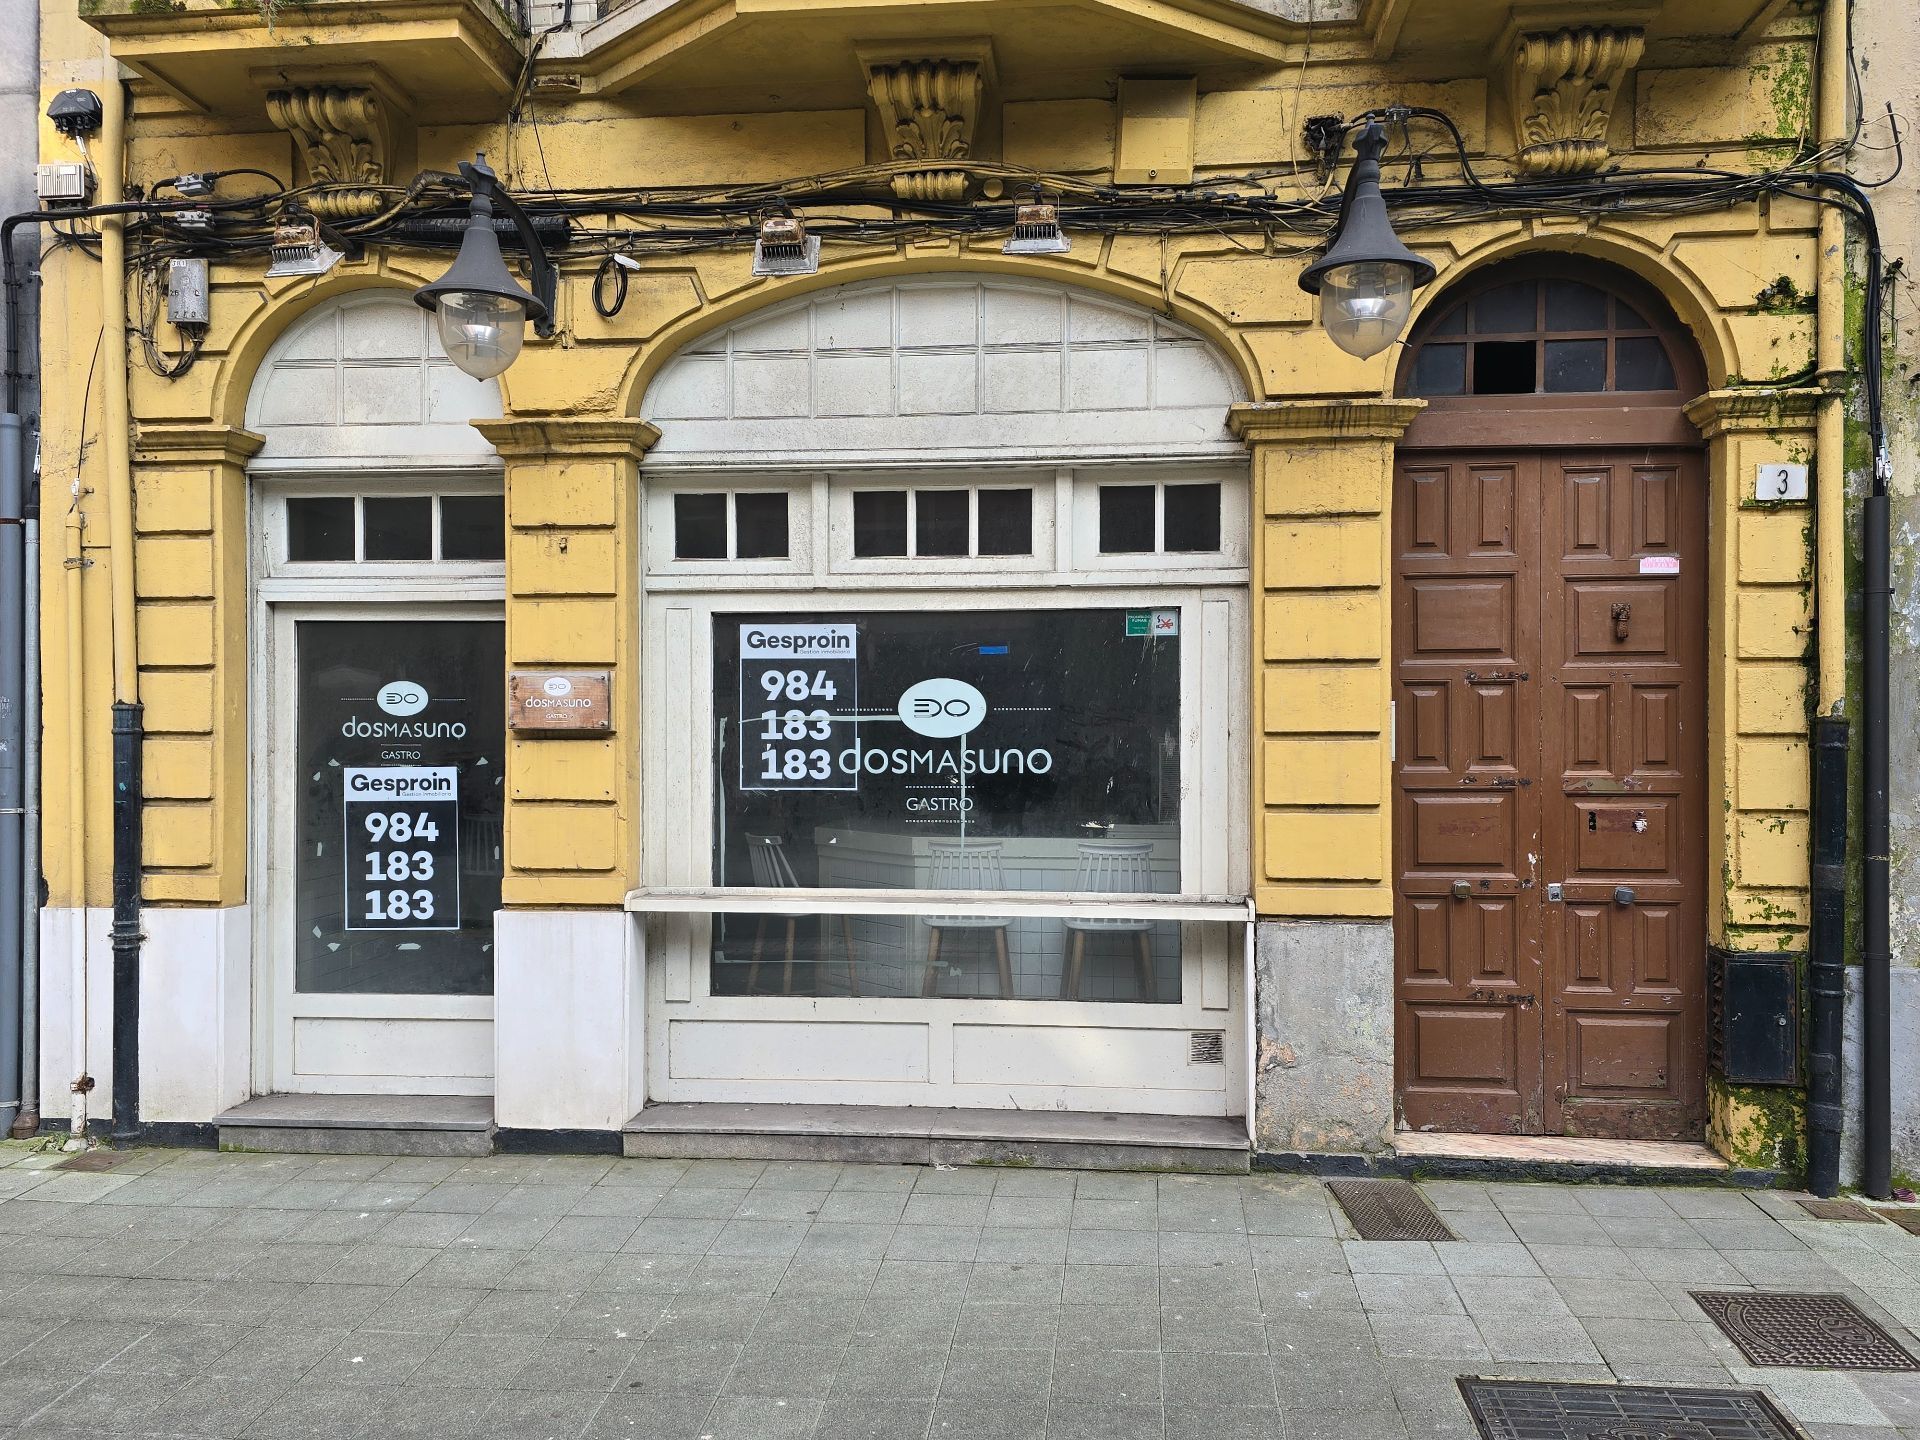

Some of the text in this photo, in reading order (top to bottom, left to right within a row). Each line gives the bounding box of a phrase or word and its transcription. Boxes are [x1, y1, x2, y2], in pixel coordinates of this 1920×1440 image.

[1777, 469, 1789, 495] 3
[746, 629, 850, 654] Gesproin
[760, 669, 837, 701] 984
[760, 709, 832, 741] 183
[380, 750, 421, 760] GASTRO
[760, 748, 832, 781] 183
[350, 771, 452, 797] Gesproin
[905, 797, 974, 812] GASTRO
[364, 811, 440, 843] 984
[364, 850, 435, 882] 183
[364, 888, 435, 921] 183
